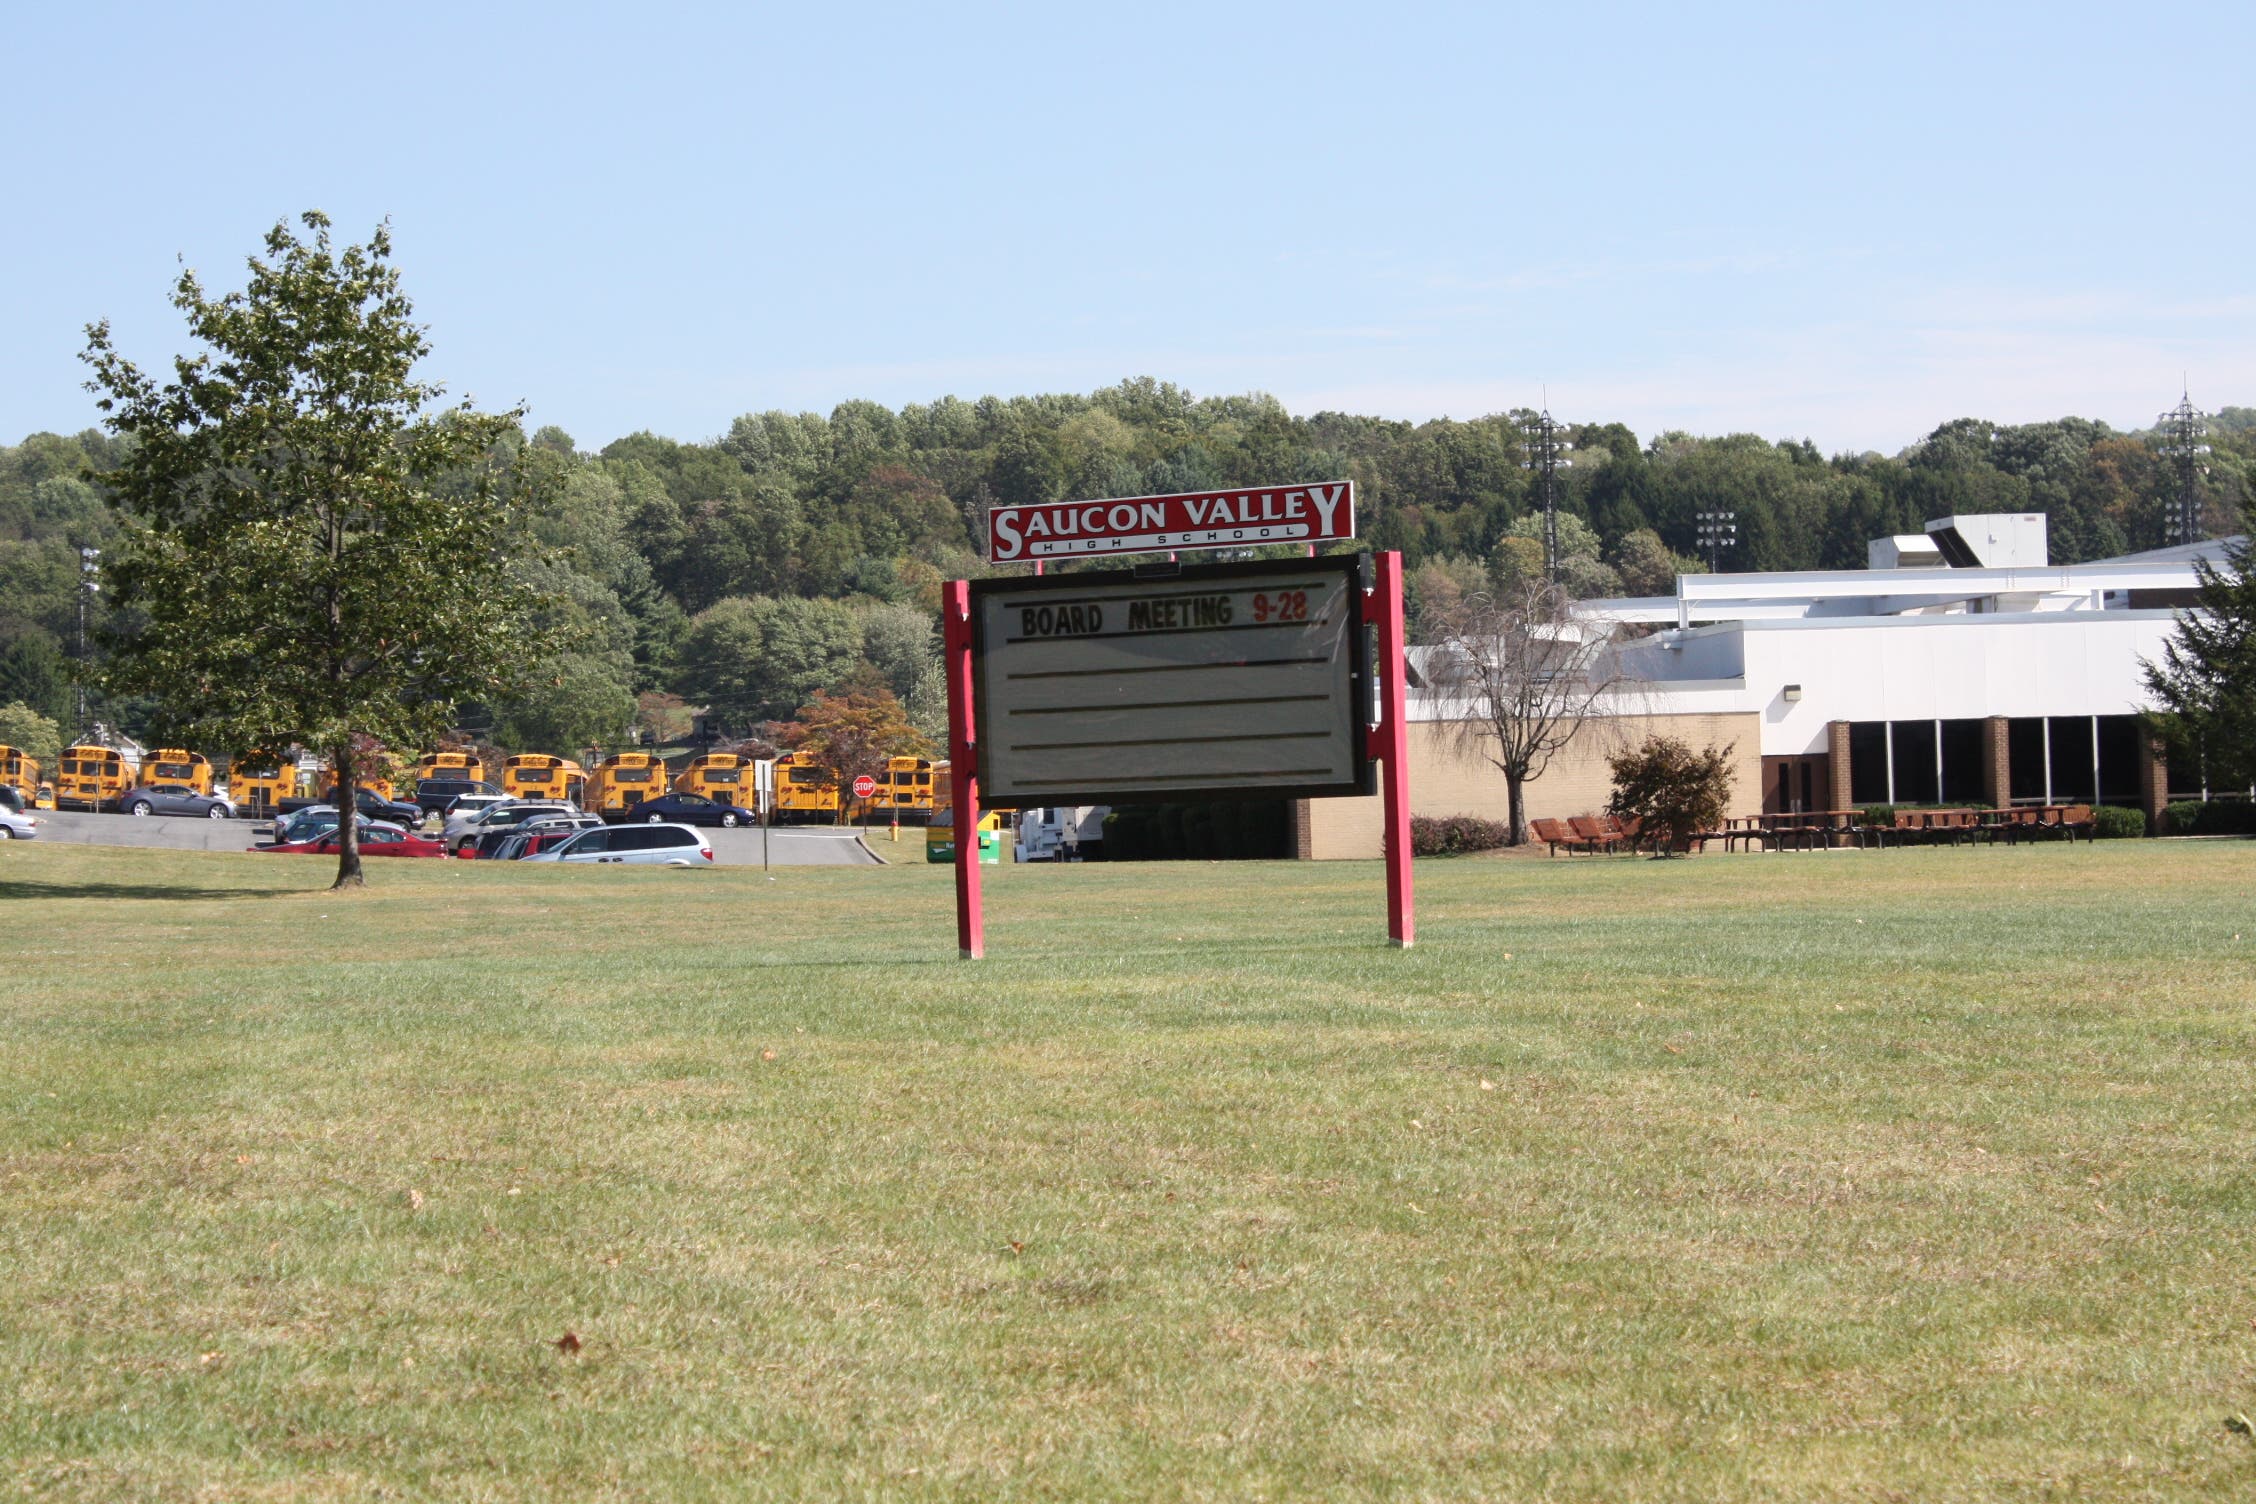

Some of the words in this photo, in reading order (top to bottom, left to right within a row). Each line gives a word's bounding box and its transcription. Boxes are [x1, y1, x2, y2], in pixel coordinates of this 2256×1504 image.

[995, 502, 1165, 559] SAUCON
[1182, 485, 1345, 537] VALLEY
[1044, 538, 1121, 552] HIGH
[1158, 527, 1294, 545] SCHOOL
[1021, 604, 1103, 637] BOARD
[1128, 595, 1233, 631] MEETING
[1252, 590, 1307, 622] 9-28
[854, 782, 873, 791] STOP
